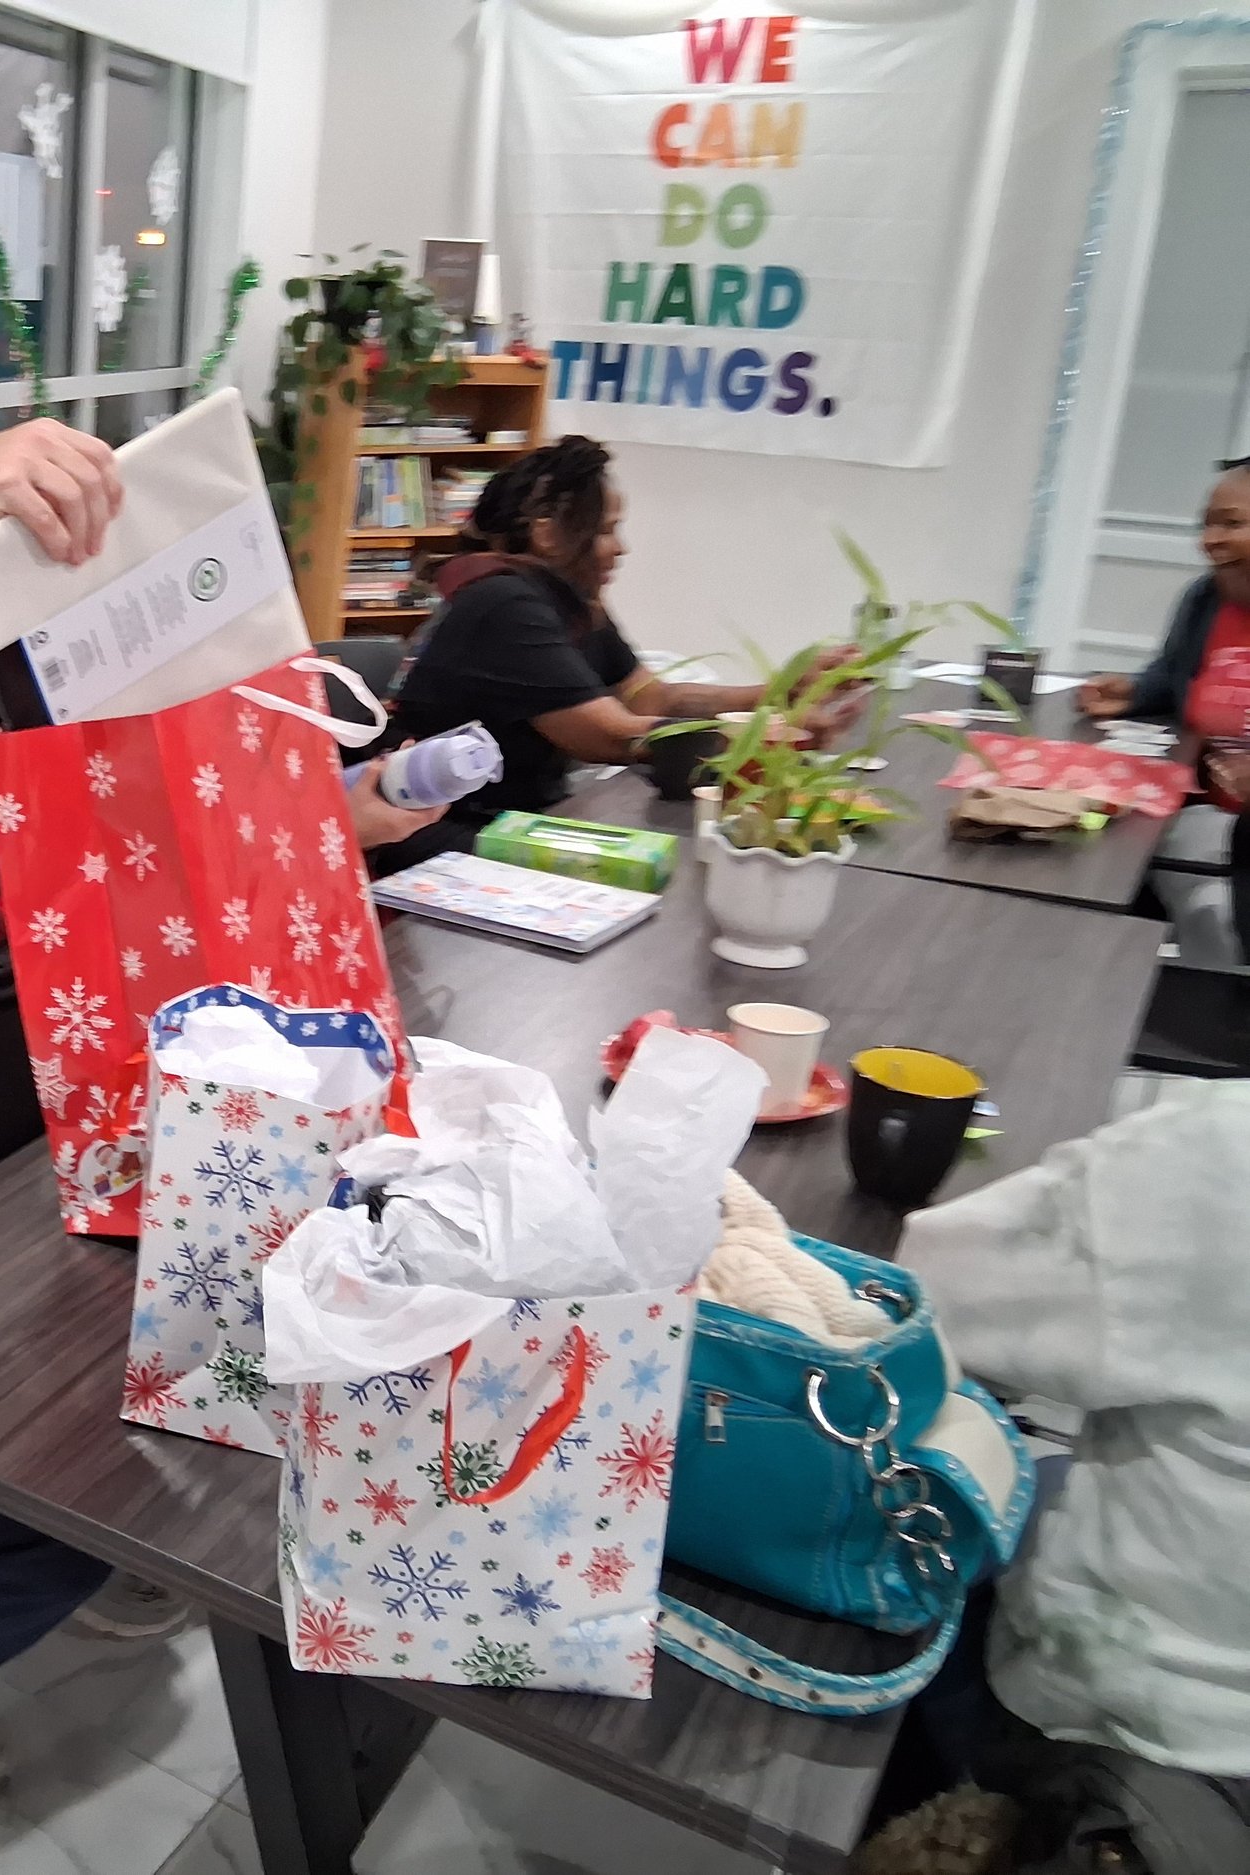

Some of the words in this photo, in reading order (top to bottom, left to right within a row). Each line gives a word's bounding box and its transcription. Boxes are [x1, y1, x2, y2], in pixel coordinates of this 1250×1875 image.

[682, 16, 799, 83] WE
[651, 102, 806, 168] CAN
[659, 183, 767, 248] DO
[603, 261, 807, 329] HARD
[551, 340, 837, 417] THINGS.
